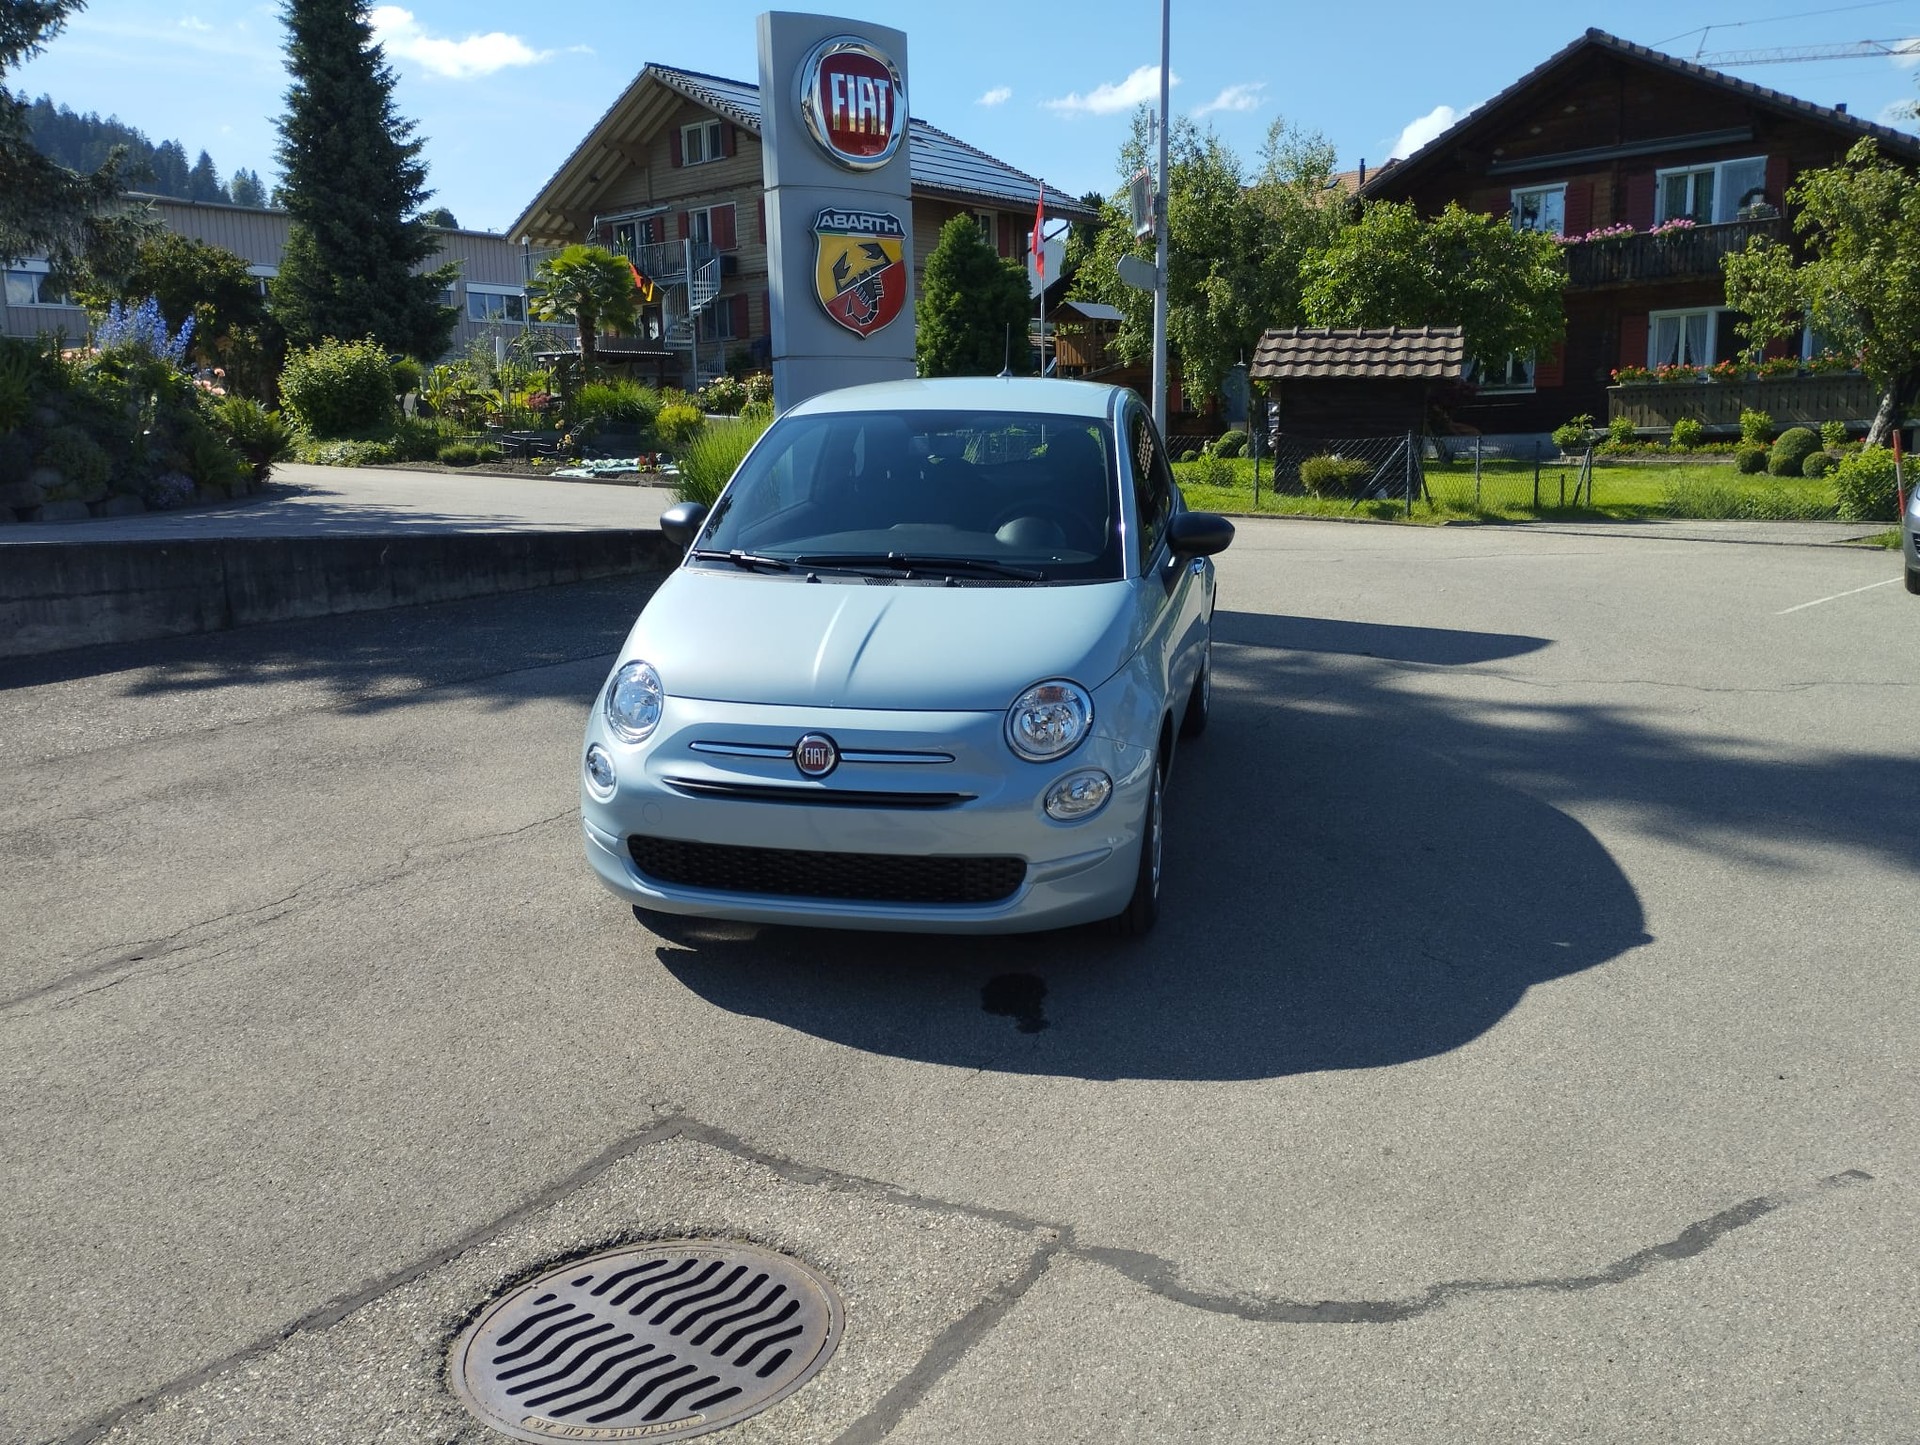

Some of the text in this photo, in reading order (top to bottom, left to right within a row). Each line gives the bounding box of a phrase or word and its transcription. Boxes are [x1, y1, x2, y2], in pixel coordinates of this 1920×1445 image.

[830, 73, 889, 136] FIAT
[820, 214, 898, 233] ABARTH
[805, 747, 827, 765] FIAT
